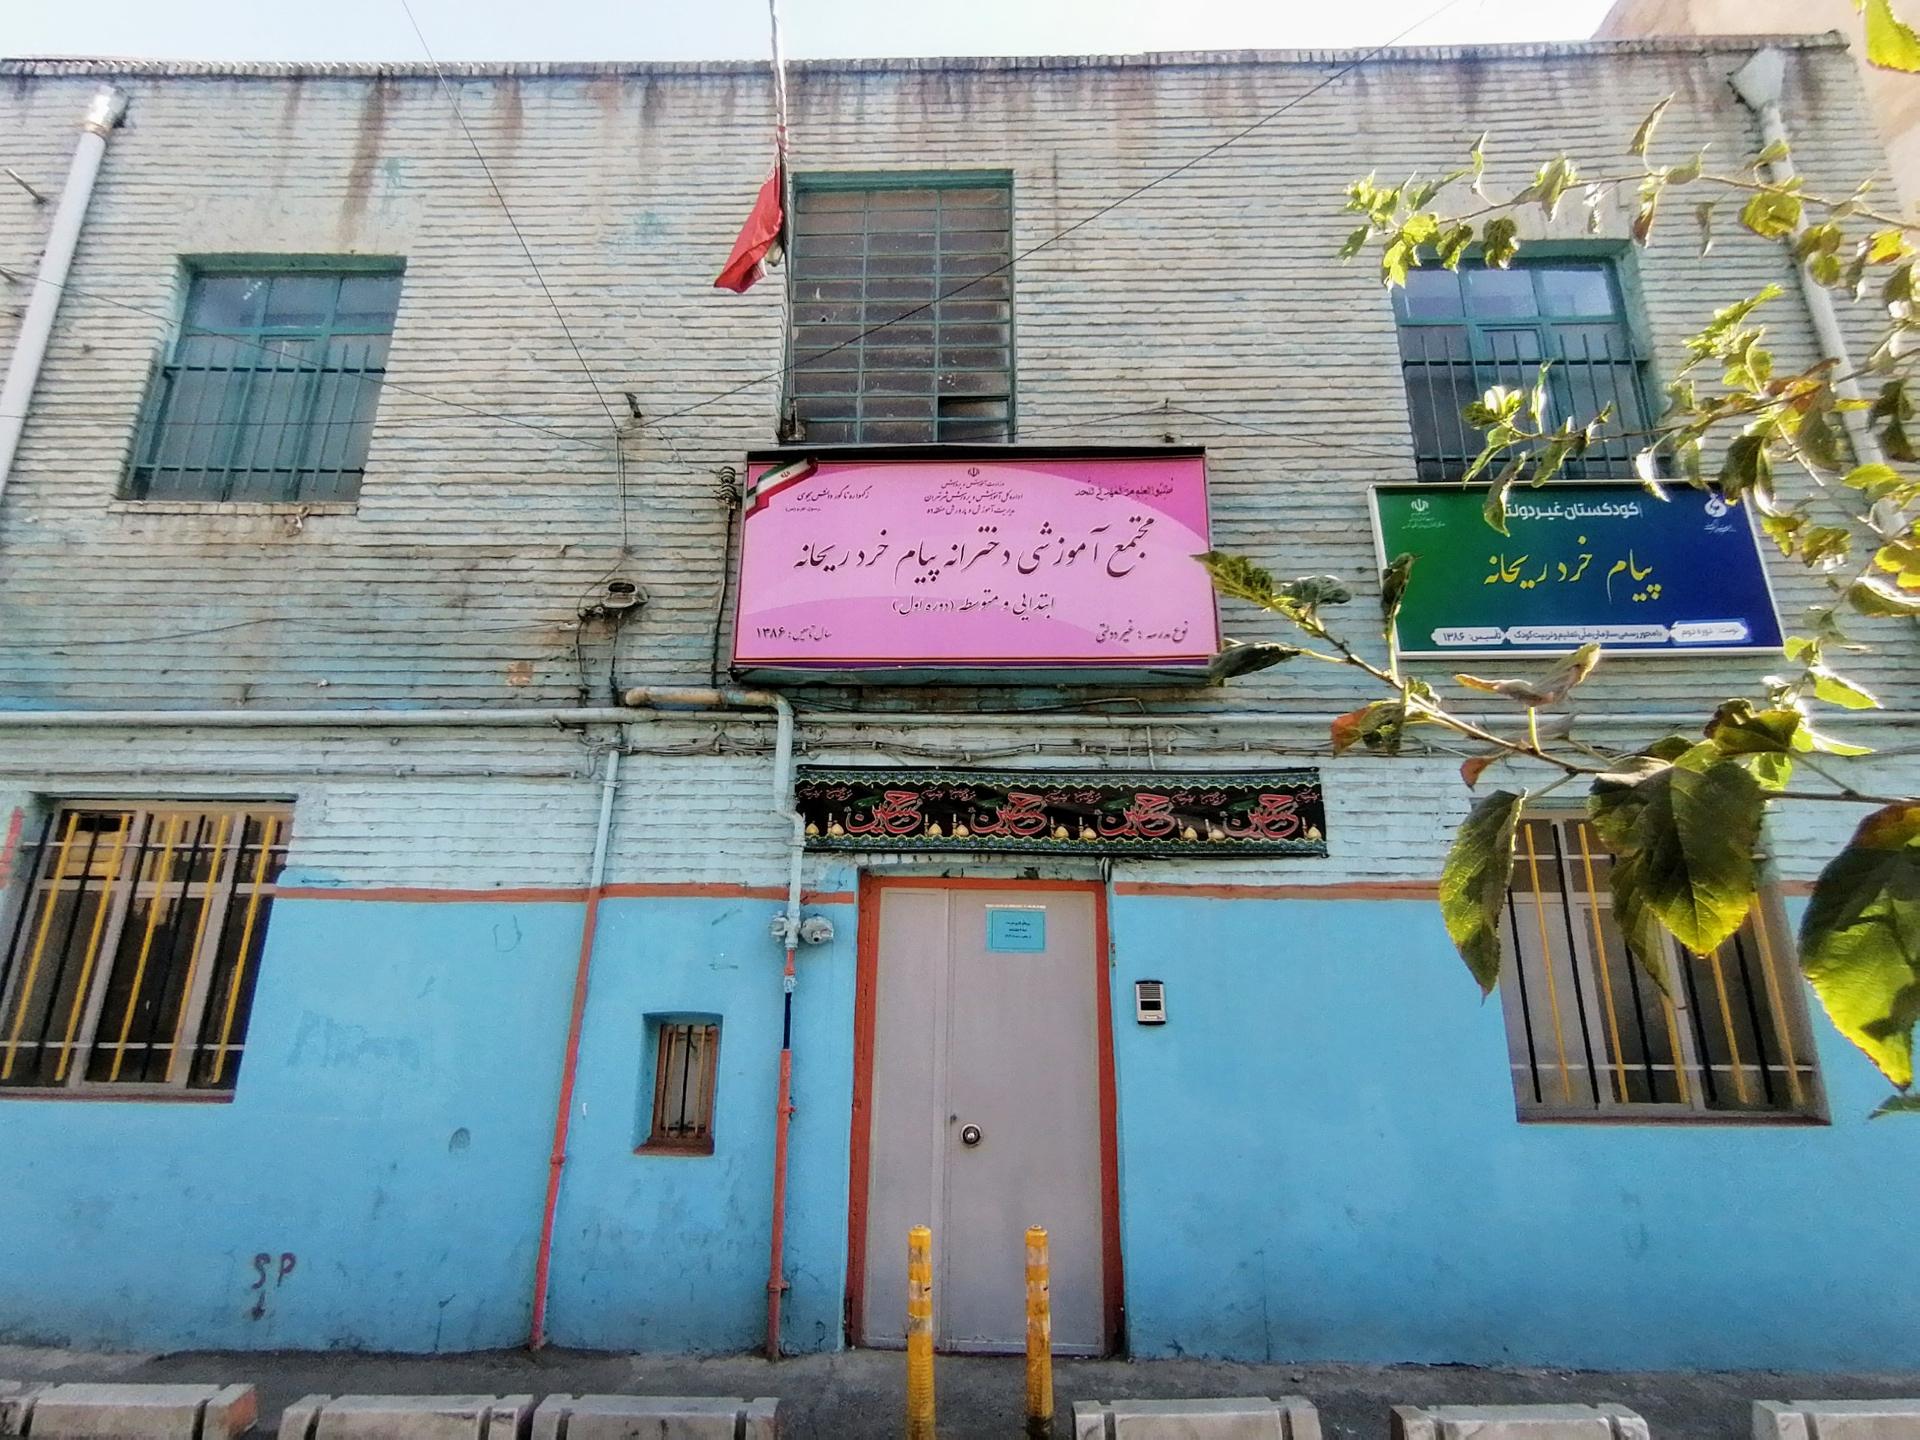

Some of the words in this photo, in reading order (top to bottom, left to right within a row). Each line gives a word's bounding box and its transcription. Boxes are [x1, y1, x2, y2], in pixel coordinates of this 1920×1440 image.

[1504, 501, 1564, 520] غیردولت
[1564, 501, 1640, 520] کودکستان
[793, 541, 850, 572] ریحانه
[856, 529, 889, 567] خرد
[894, 539, 940, 586] پیام
[943, 526, 1011, 573] دخترانه
[1016, 521, 1112, 575] آموزشی
[1106, 515, 1155, 578] مجتمع
[1557, 535, 1593, 582] خرد
[1483, 553, 1548, 590] ریحانه
[1607, 548, 1662, 605] پیام
[756, 626, 785, 639] ۱۳۸۶
[1443, 631, 1465, 641] ۱۳۸۶
